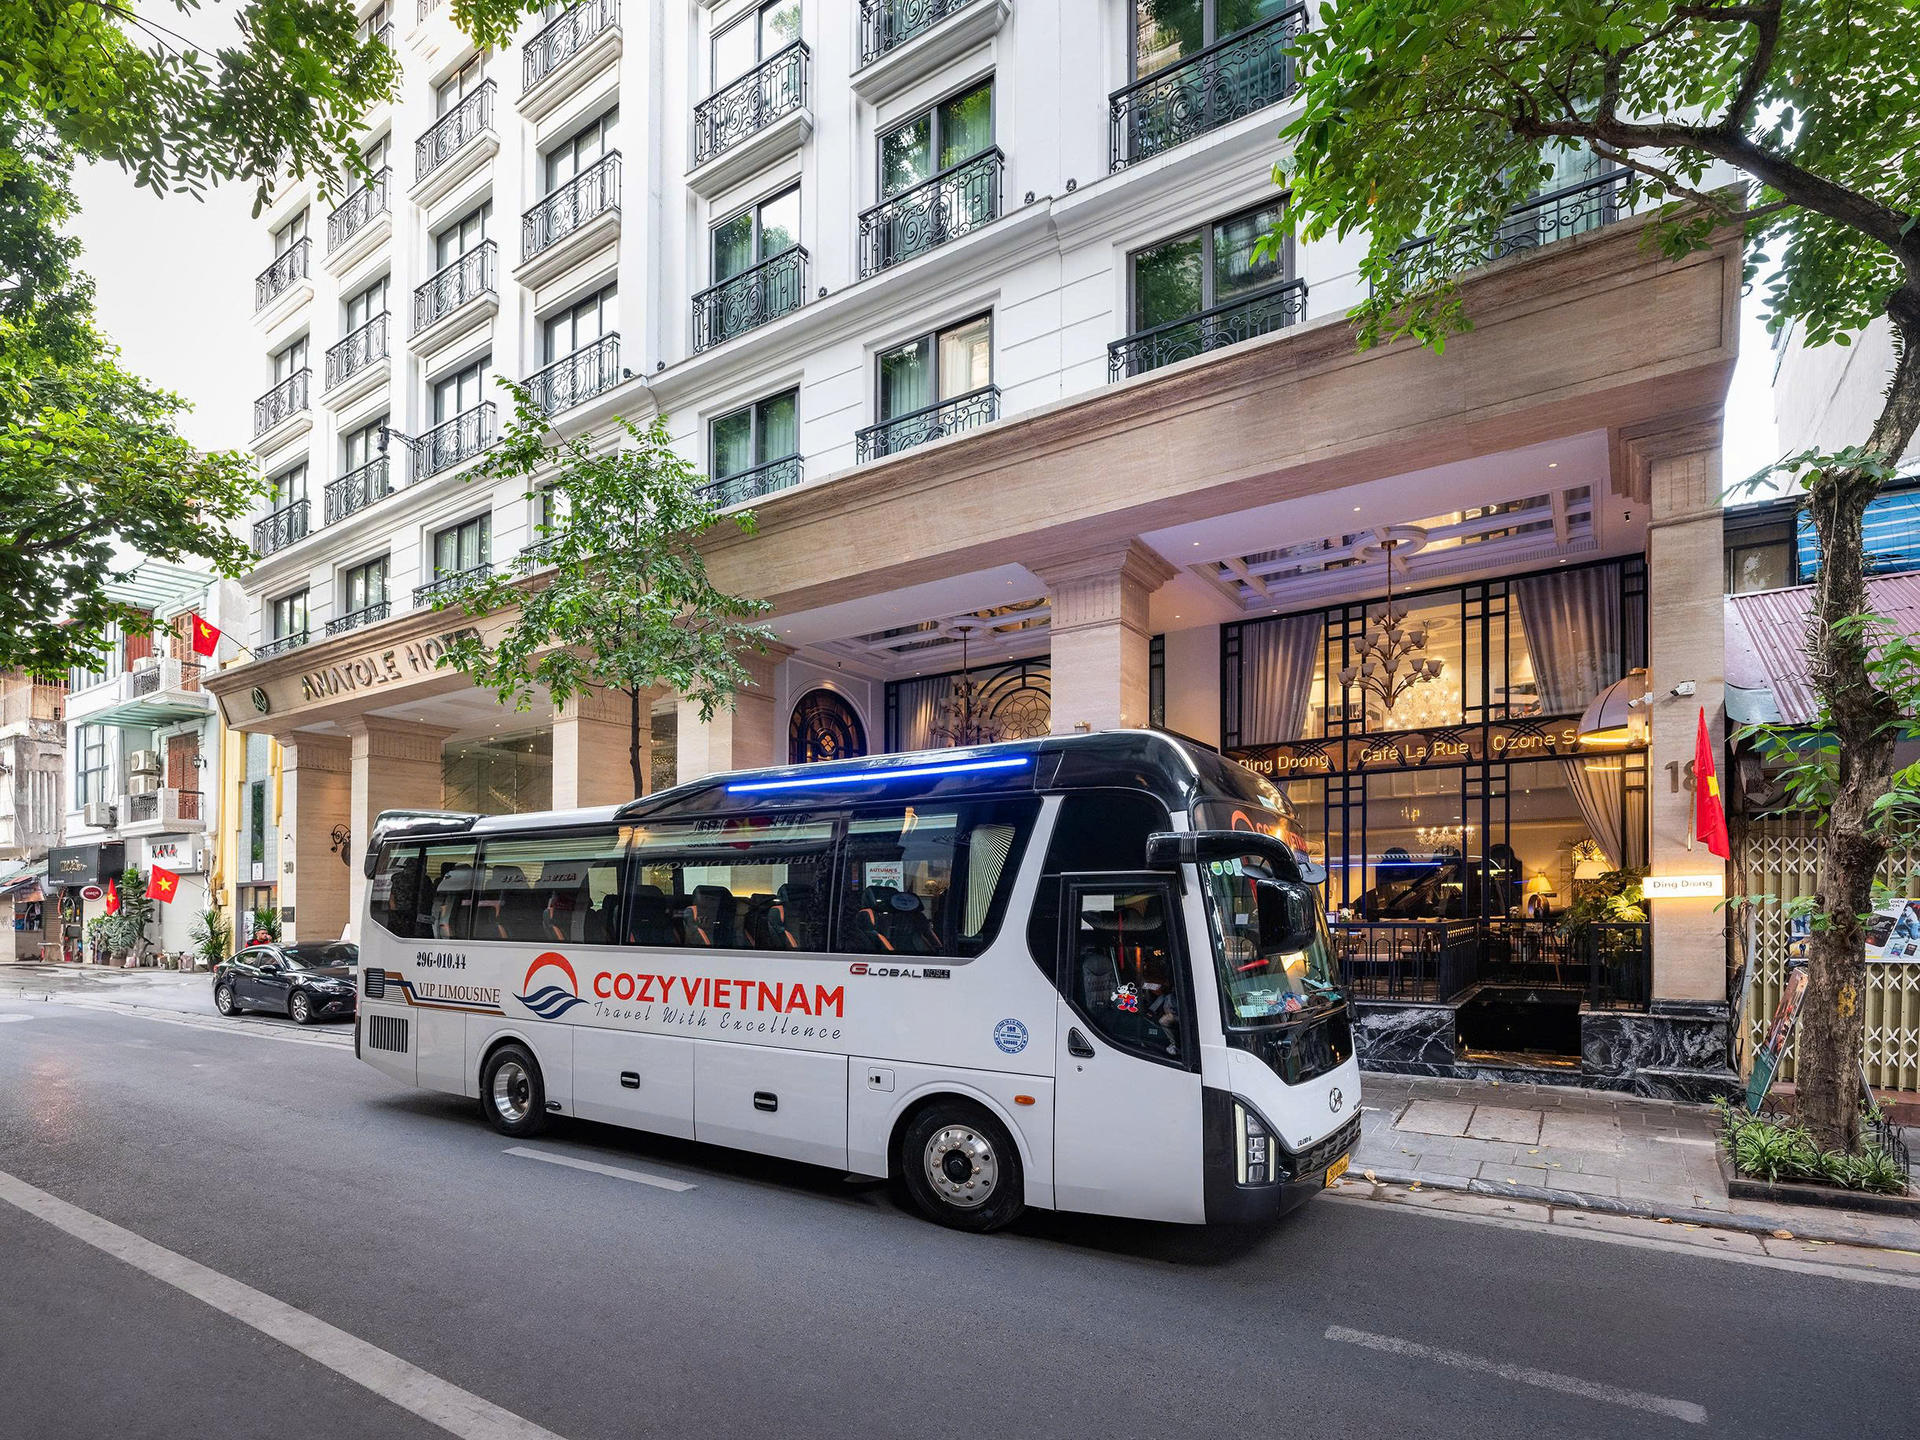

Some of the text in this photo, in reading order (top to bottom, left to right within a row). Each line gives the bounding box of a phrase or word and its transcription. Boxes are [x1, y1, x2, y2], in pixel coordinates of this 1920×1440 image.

[302, 650, 402, 701] ANATOLE
[1359, 741, 1469, 762] Café La Rue
[1492, 734, 1556, 751] Ozone
[1278, 755, 1329, 769] Doong
[1653, 880, 1678, 889] Ding
[416, 951, 467, 969] 29G-010.44
[418, 982, 501, 1004] VIP LIMOUSINE
[594, 1001, 842, 1040] Travel With Excellence
